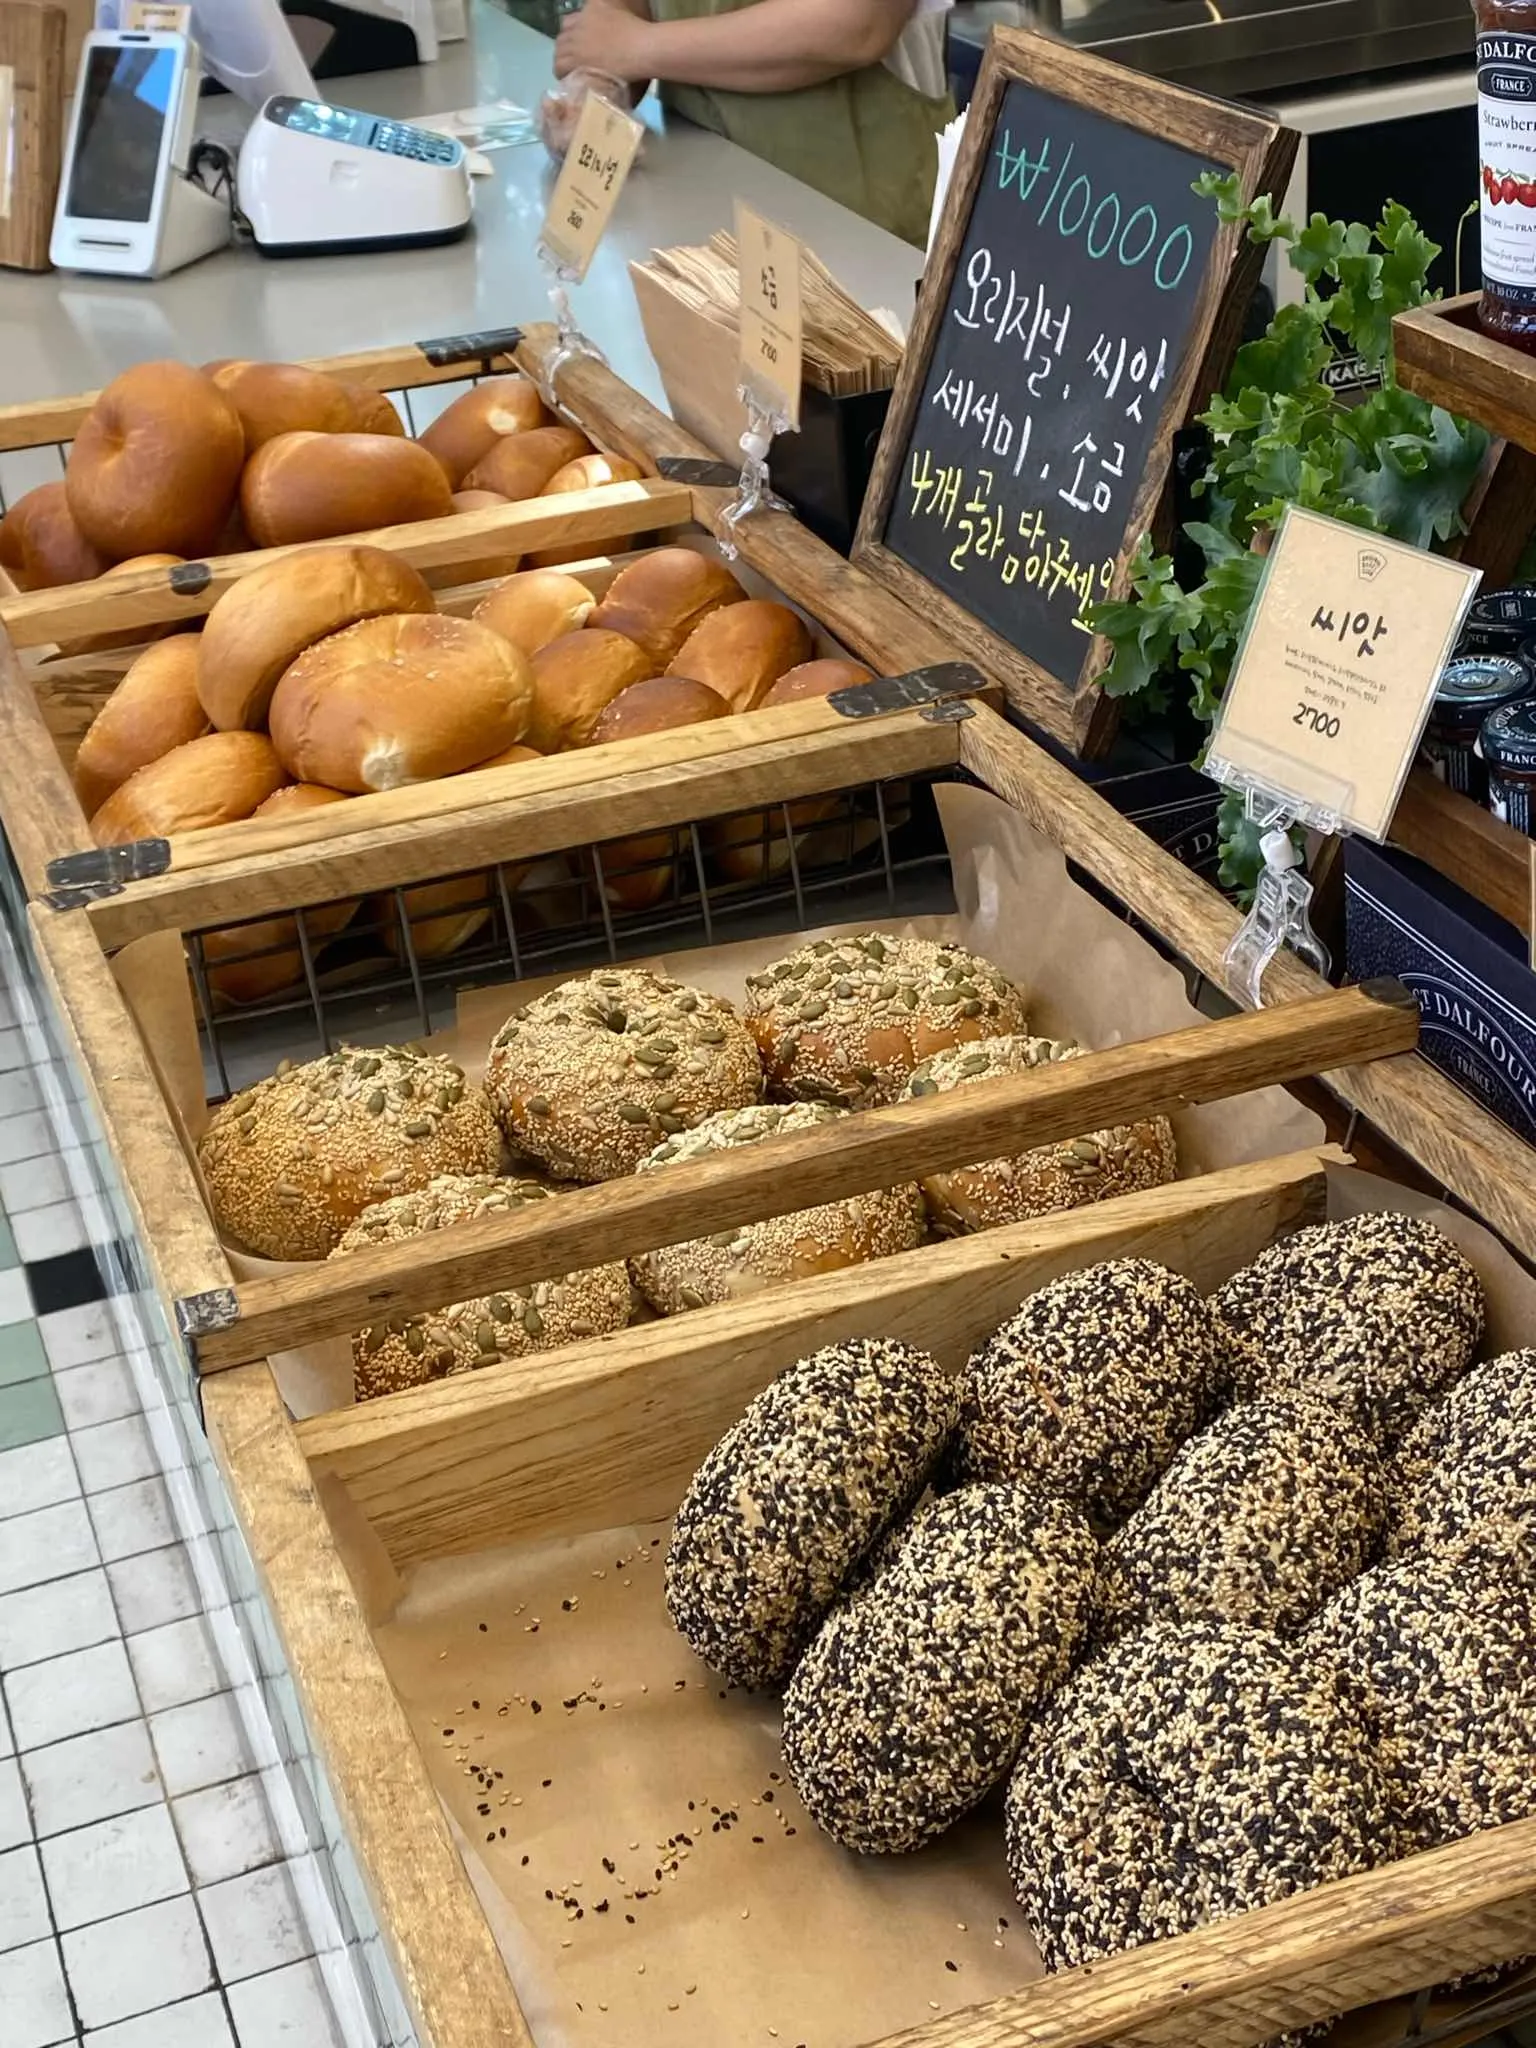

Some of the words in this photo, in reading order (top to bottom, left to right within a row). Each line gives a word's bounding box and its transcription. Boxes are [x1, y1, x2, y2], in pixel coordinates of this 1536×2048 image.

[1496, 78, 1525, 92] FRANCE
[1086, 333, 1167, 424] 씨앗
[1058, 432, 1125, 513] 소금
[1310, 605, 1388, 658] 씨앗
[1292, 701, 1341, 738] 2700
[1434, 991, 1536, 1109] DALFOUR
[1457, 1055, 1491, 1094] FRANCE
